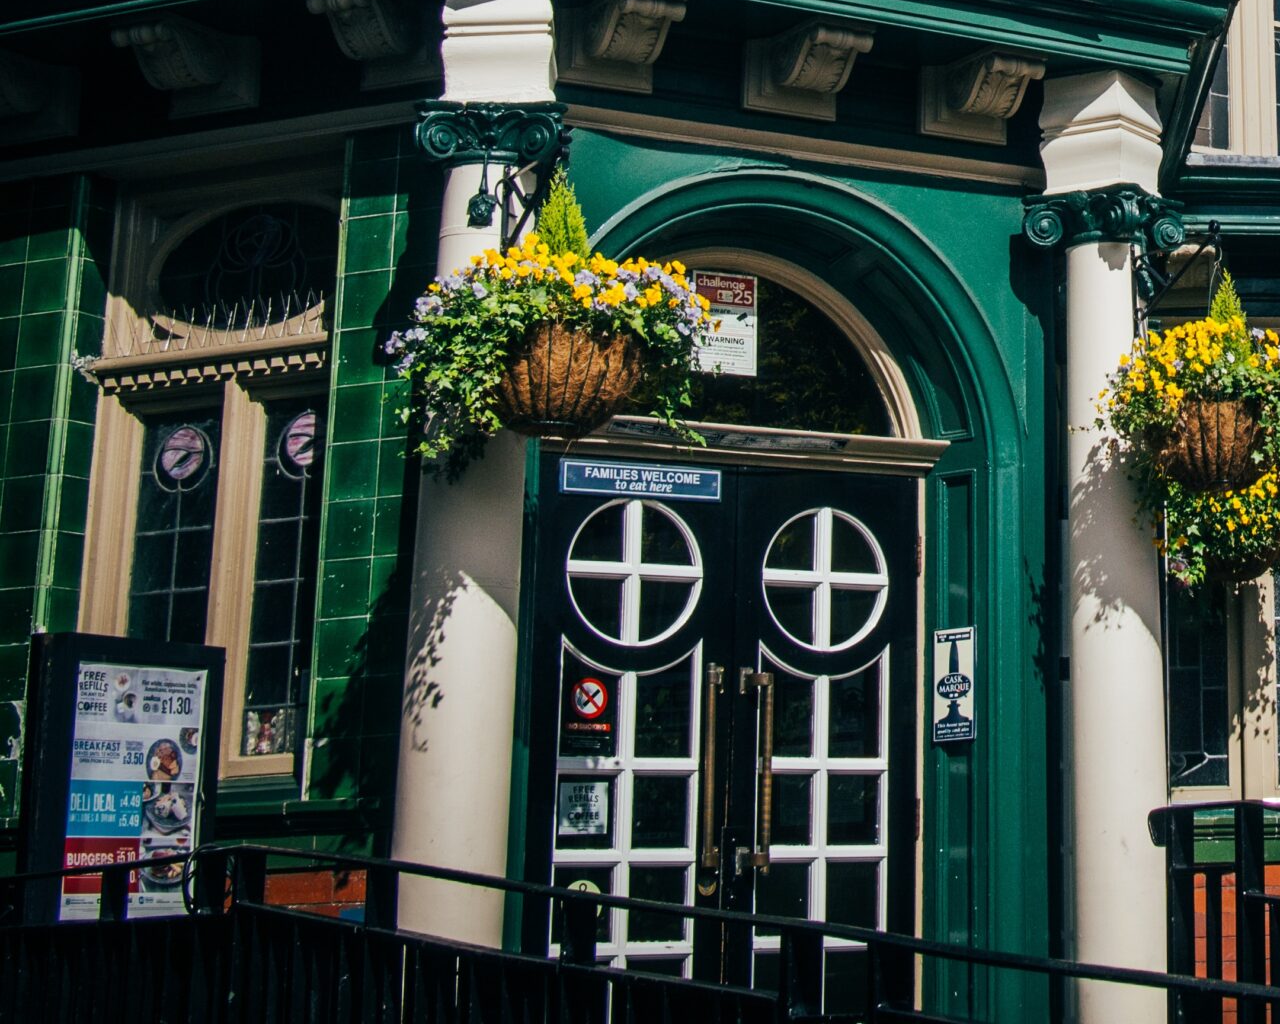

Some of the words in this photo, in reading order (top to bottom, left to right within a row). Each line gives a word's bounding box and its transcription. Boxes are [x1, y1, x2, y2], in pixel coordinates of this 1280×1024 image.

[698, 275, 746, 291] challenge
[734, 290, 753, 305] 25
[707, 336, 745, 346] WARNING
[585, 467, 639, 480] FAMILIES
[641, 470, 701, 485] WELCOME
[615, 479, 627, 490] to
[629, 481, 648, 491] eat
[650, 481, 673, 493] here
[84, 671, 107, 682] FREE
[944, 675, 963, 685] CASK
[79, 681, 109, 693] REFILLS
[939, 682, 970, 693] MARQUE
[78, 701, 108, 712] COFFEE
[162, 696, 191, 715] £1.30
[74, 740, 121, 752] BREAKFAST
[123, 752, 145, 765] £3.50
[573, 785, 595, 794] FREE
[70, 792, 91, 812] DELI
[93, 792, 117, 812] DEAL
[568, 793, 600, 803] REFILLS
[568, 811, 599, 821] COFFEE
[66, 852, 114, 866] BURGERS
